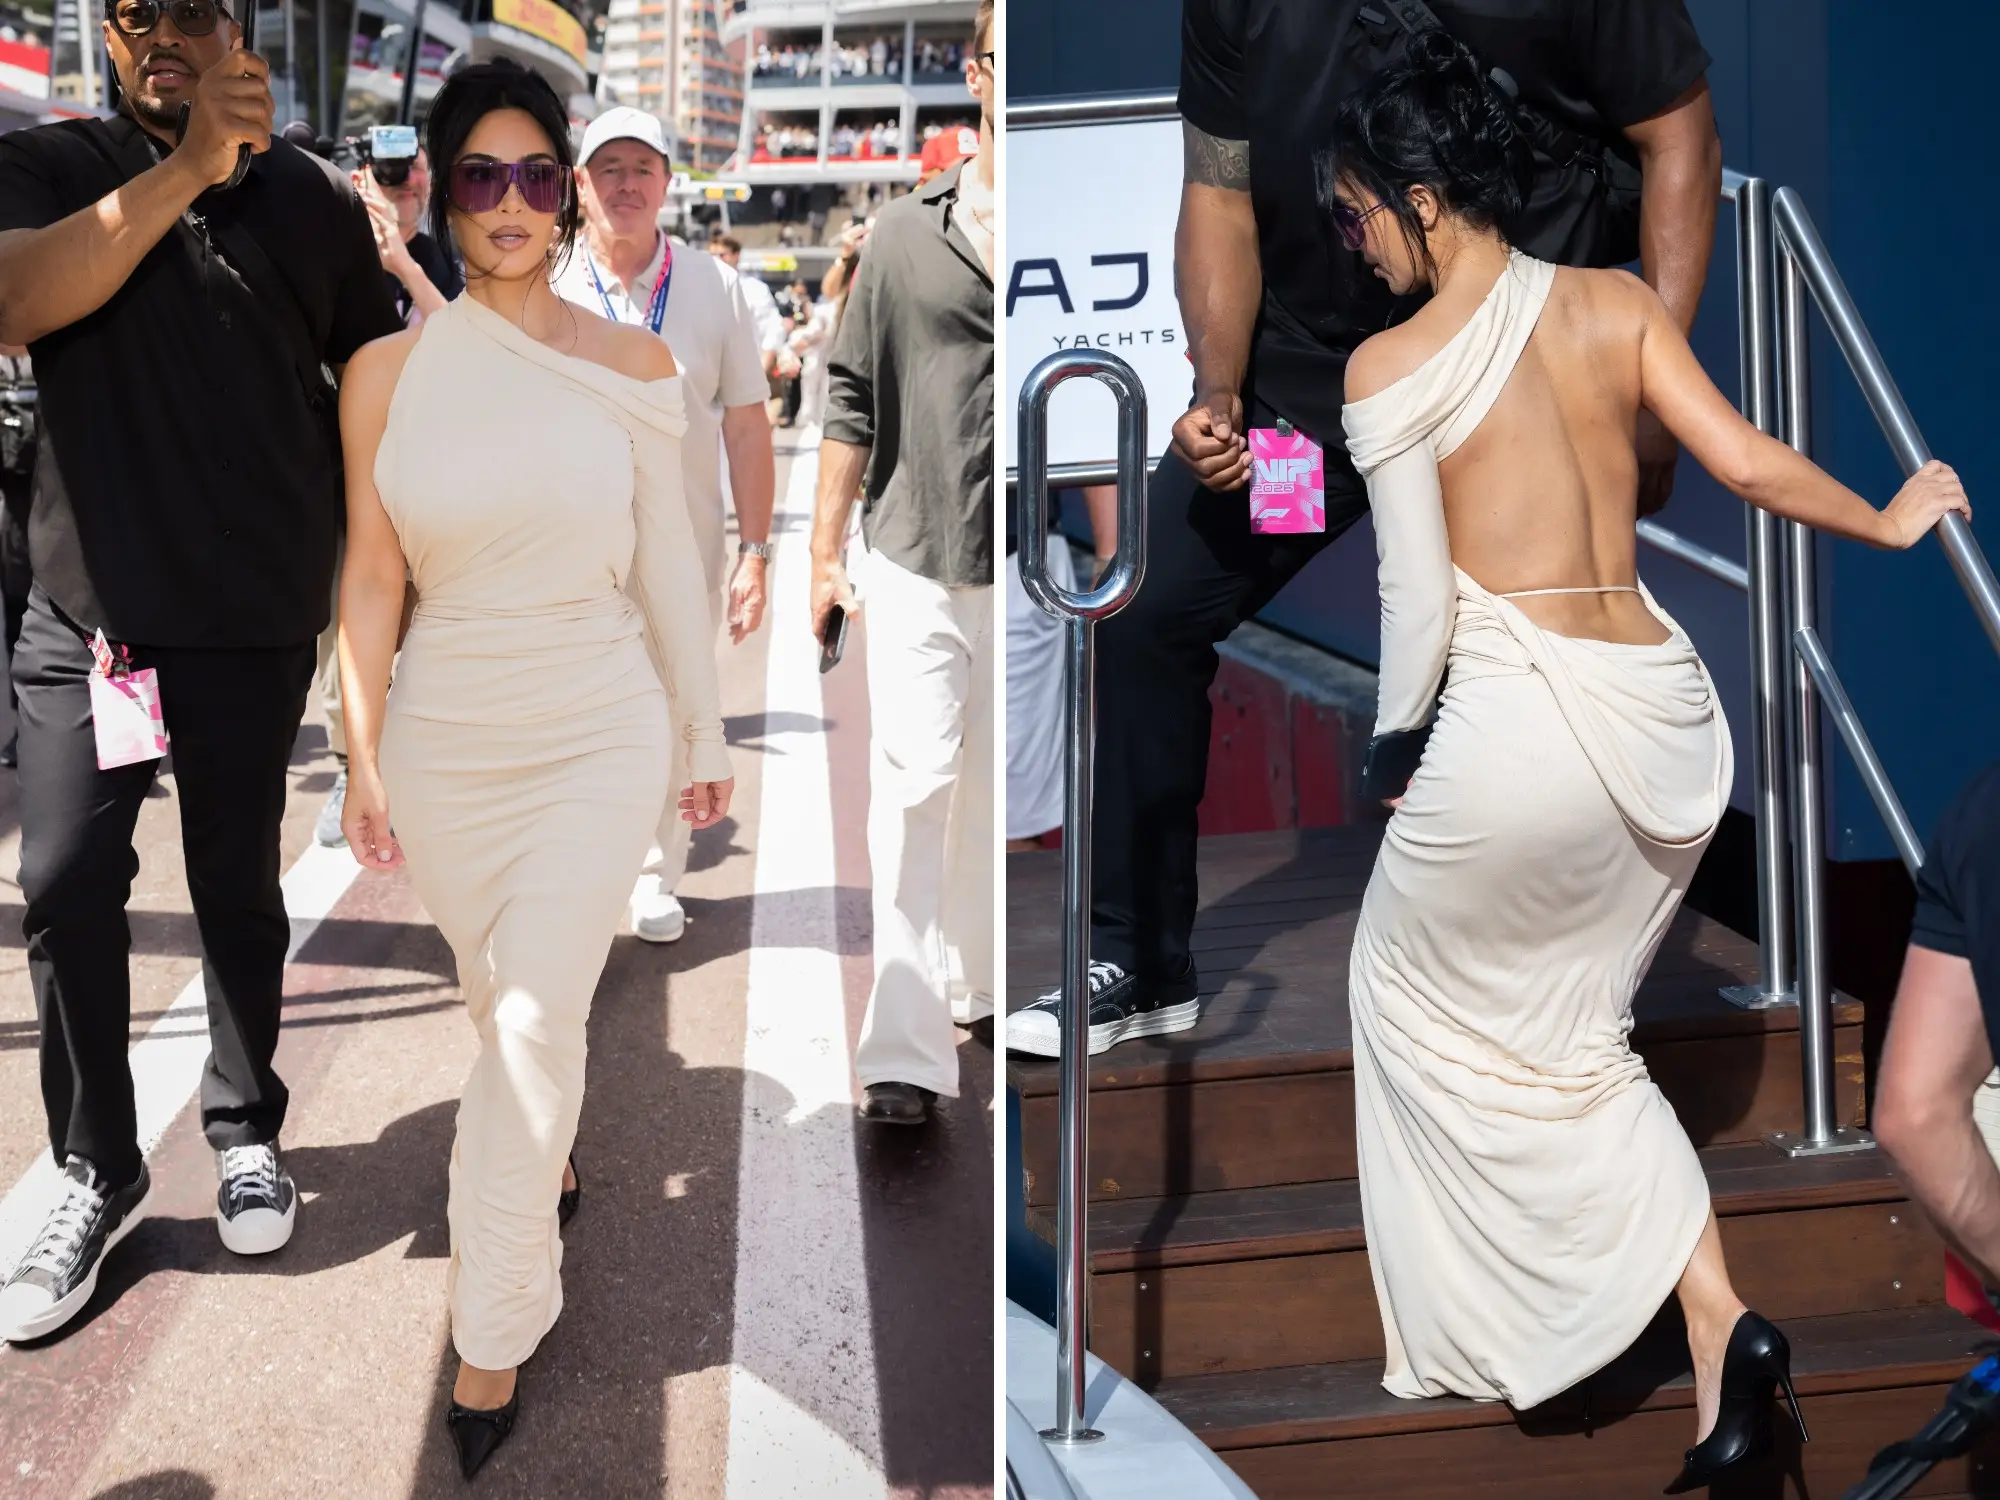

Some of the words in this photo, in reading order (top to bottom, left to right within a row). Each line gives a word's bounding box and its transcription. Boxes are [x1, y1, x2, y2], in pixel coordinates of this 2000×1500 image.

[1053, 329, 1175, 349] YACHTS
[1255, 458, 1311, 482] VIP
[1252, 483, 1295, 494] 2026
